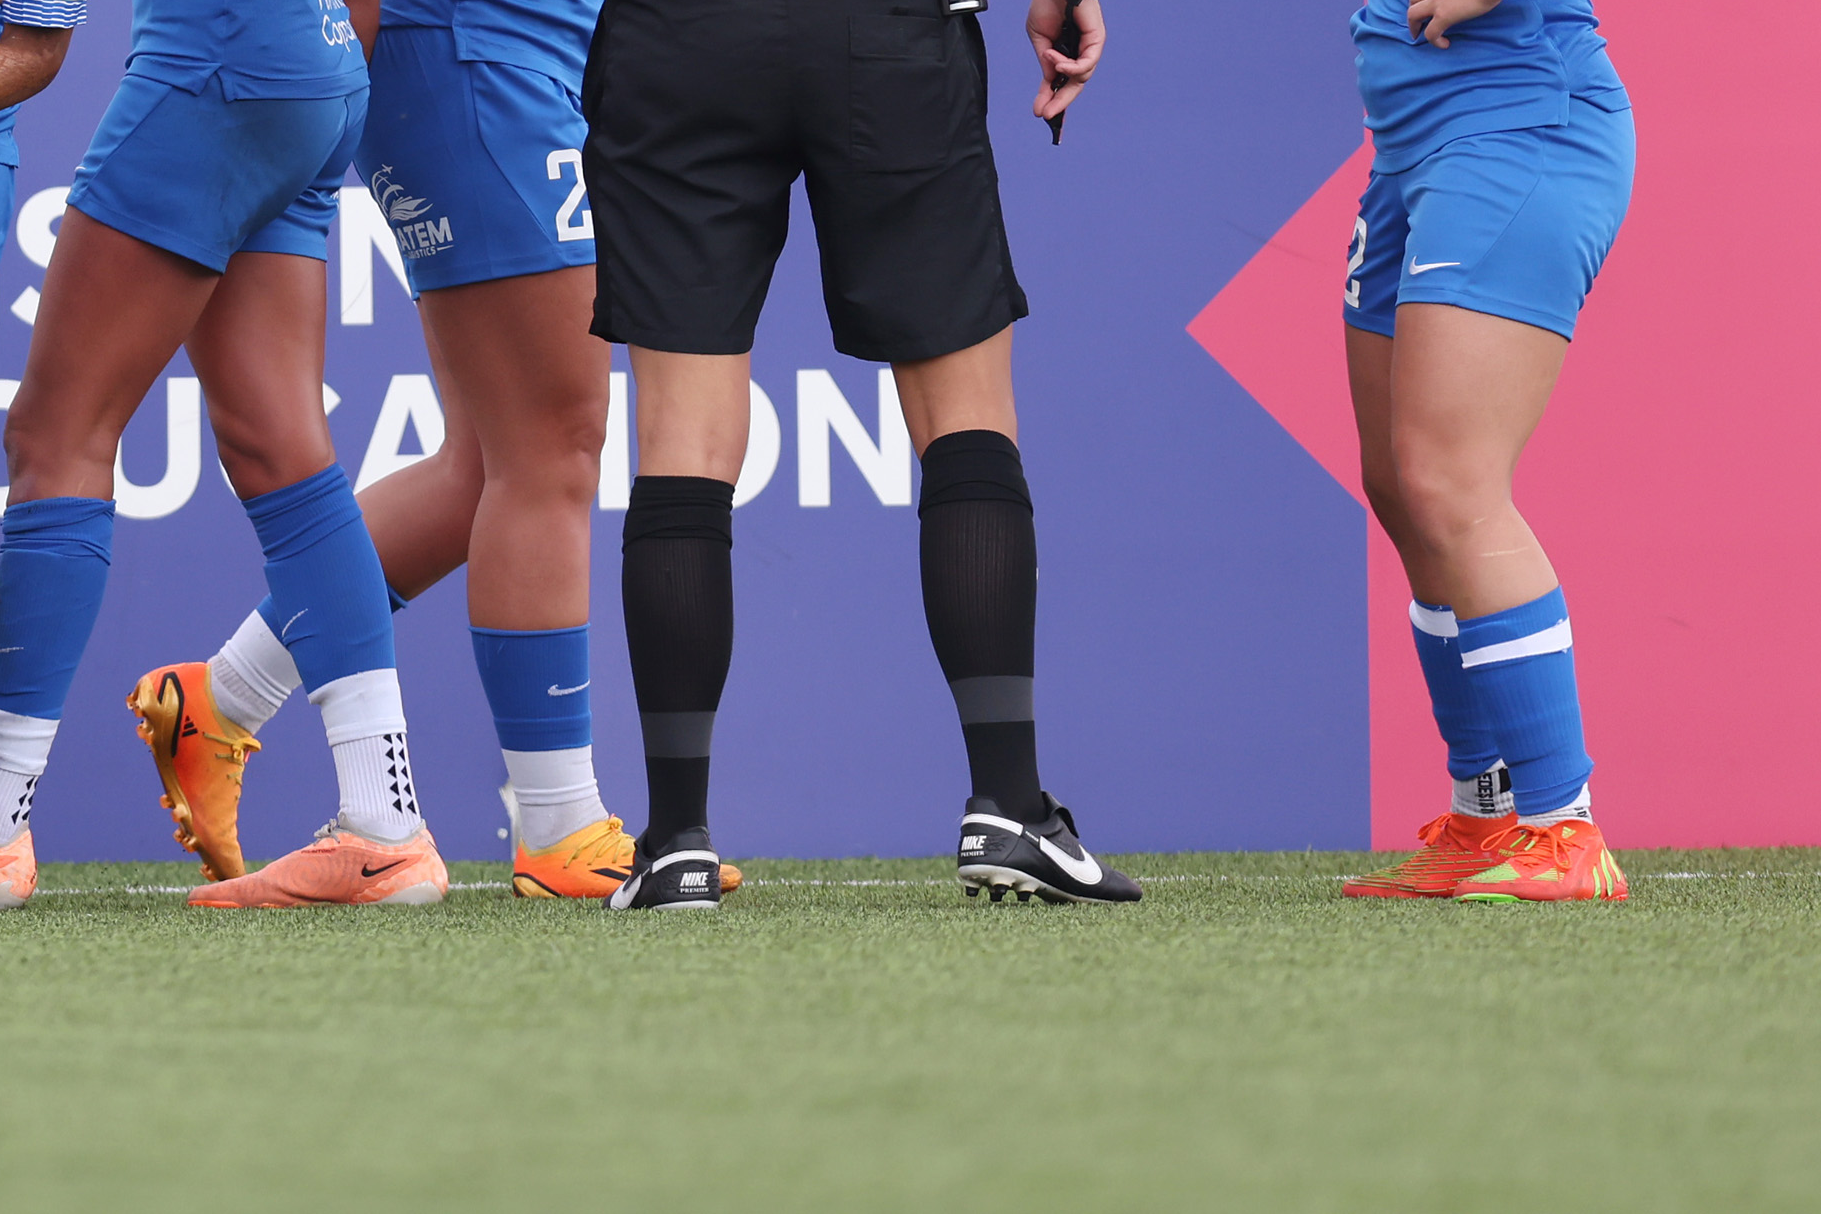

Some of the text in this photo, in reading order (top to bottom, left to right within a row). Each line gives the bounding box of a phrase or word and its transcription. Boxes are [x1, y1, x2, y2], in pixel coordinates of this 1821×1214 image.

[396, 216, 454, 252] ATEM
[961, 835, 987, 852] NIKE
[680, 871, 709, 887] NIKE
